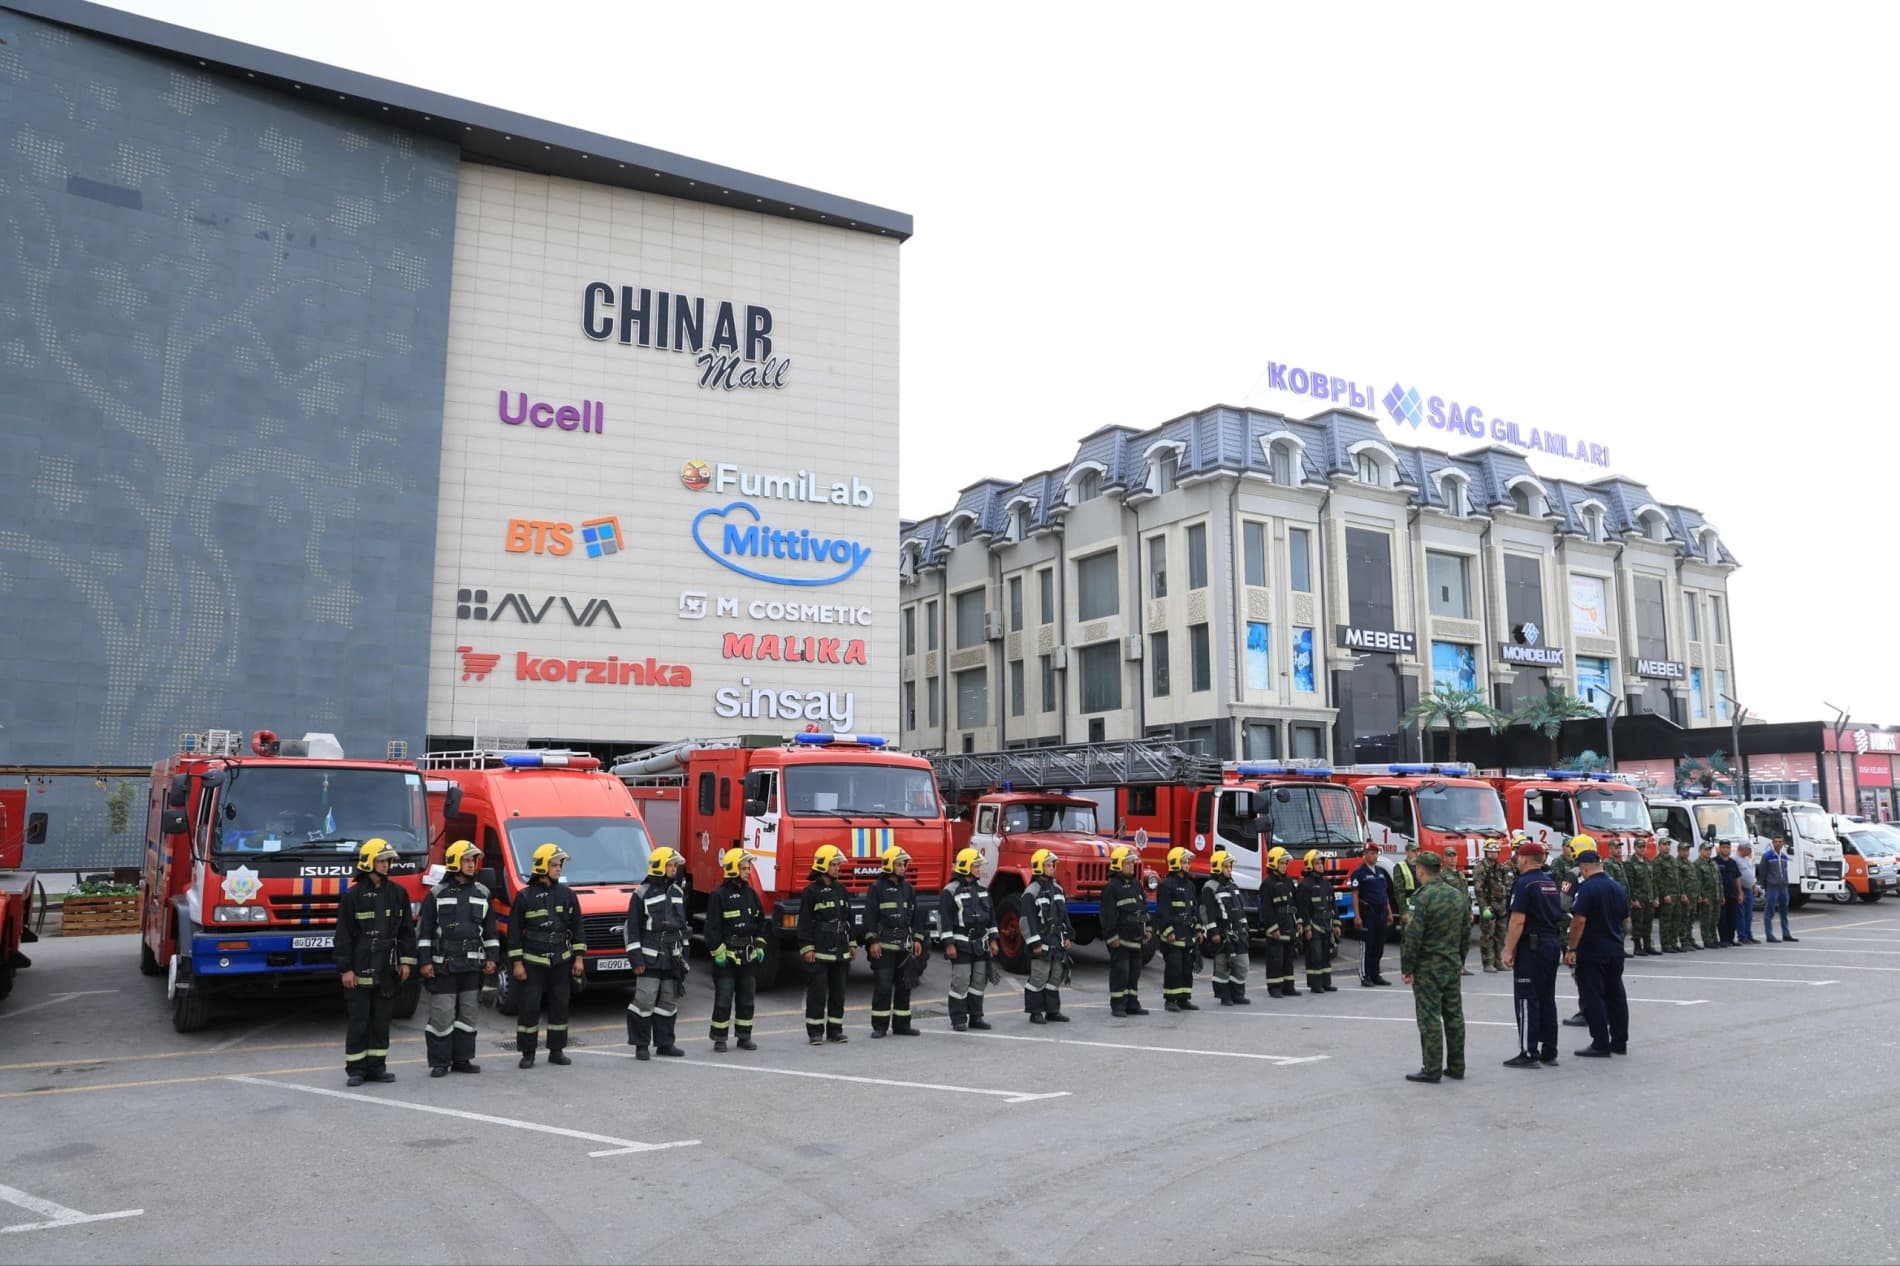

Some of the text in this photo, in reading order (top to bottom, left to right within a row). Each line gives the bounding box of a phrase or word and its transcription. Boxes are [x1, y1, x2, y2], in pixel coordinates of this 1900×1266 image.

[582, 280, 774, 363] CHINAR
[697, 351, 792, 391] Mall
[1268, 360, 1375, 411] КОВРЫ
[500, 390, 604, 434] Ucell
[1427, 395, 1610, 467] SAG GILAMLARI
[715, 463, 873, 508] FumiLab
[505, 518, 574, 556] BTS
[723, 523, 872, 568] Mittivoy
[490, 593, 622, 629] AVVA
[716, 596, 873, 627] M COSMETIC
[722, 632, 867, 665] MALIKA
[1344, 627, 1412, 651] MEBEL
[1502, 646, 1563, 664] MONDELUX
[516, 651, 692, 687] korzinka
[1636, 659, 1683, 677] MEBEL
[715, 677, 855, 733] sinsay
[755, 827, 761, 849] 6
[1382, 827, 1388, 844] 1
[300, 866, 353, 877] ISUZU
[854, 867, 882, 875] KAMA
